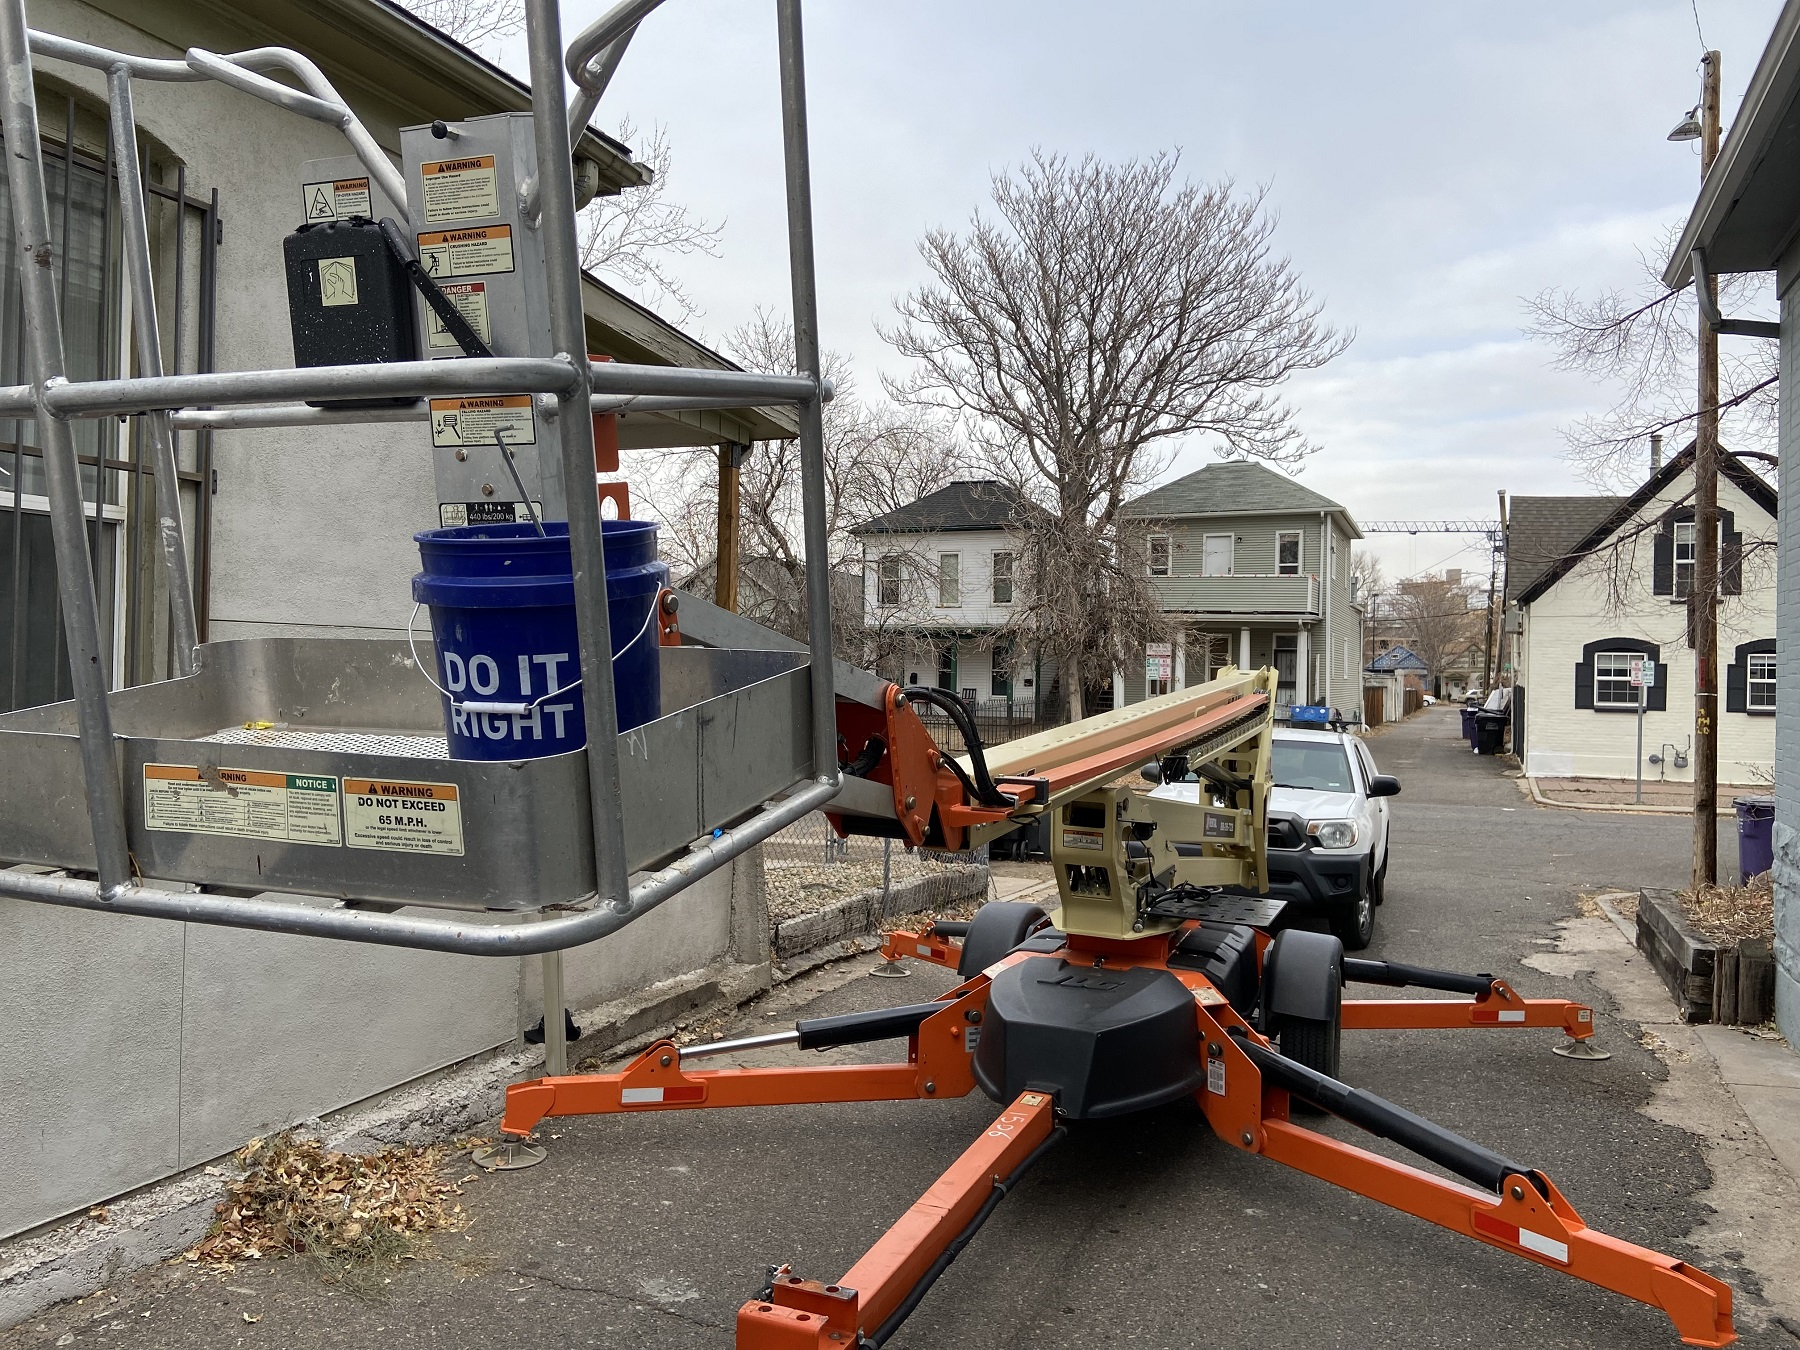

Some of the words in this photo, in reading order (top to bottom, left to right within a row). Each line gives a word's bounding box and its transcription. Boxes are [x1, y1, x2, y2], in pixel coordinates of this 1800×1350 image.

[445, 160, 481, 171] WARNING
[450, 231, 487, 241] WARNING
[441, 286, 472, 294] DANGER
[467, 400, 504, 408] WARNING
[506, 513, 513, 521] kg
[444, 652, 499, 695] DO
[518, 653, 568, 696] IT
[451, 704, 573, 740] RIGHT
[296, 779, 327, 789] NOTICE
[381, 785, 433, 797] WARNING
[358, 797, 373, 806] DO
[377, 798, 399, 808] NOT
[402, 800, 445, 812] EXCEED
[379, 815, 392, 825] 65
[395, 816, 427, 828] M.P.H.
